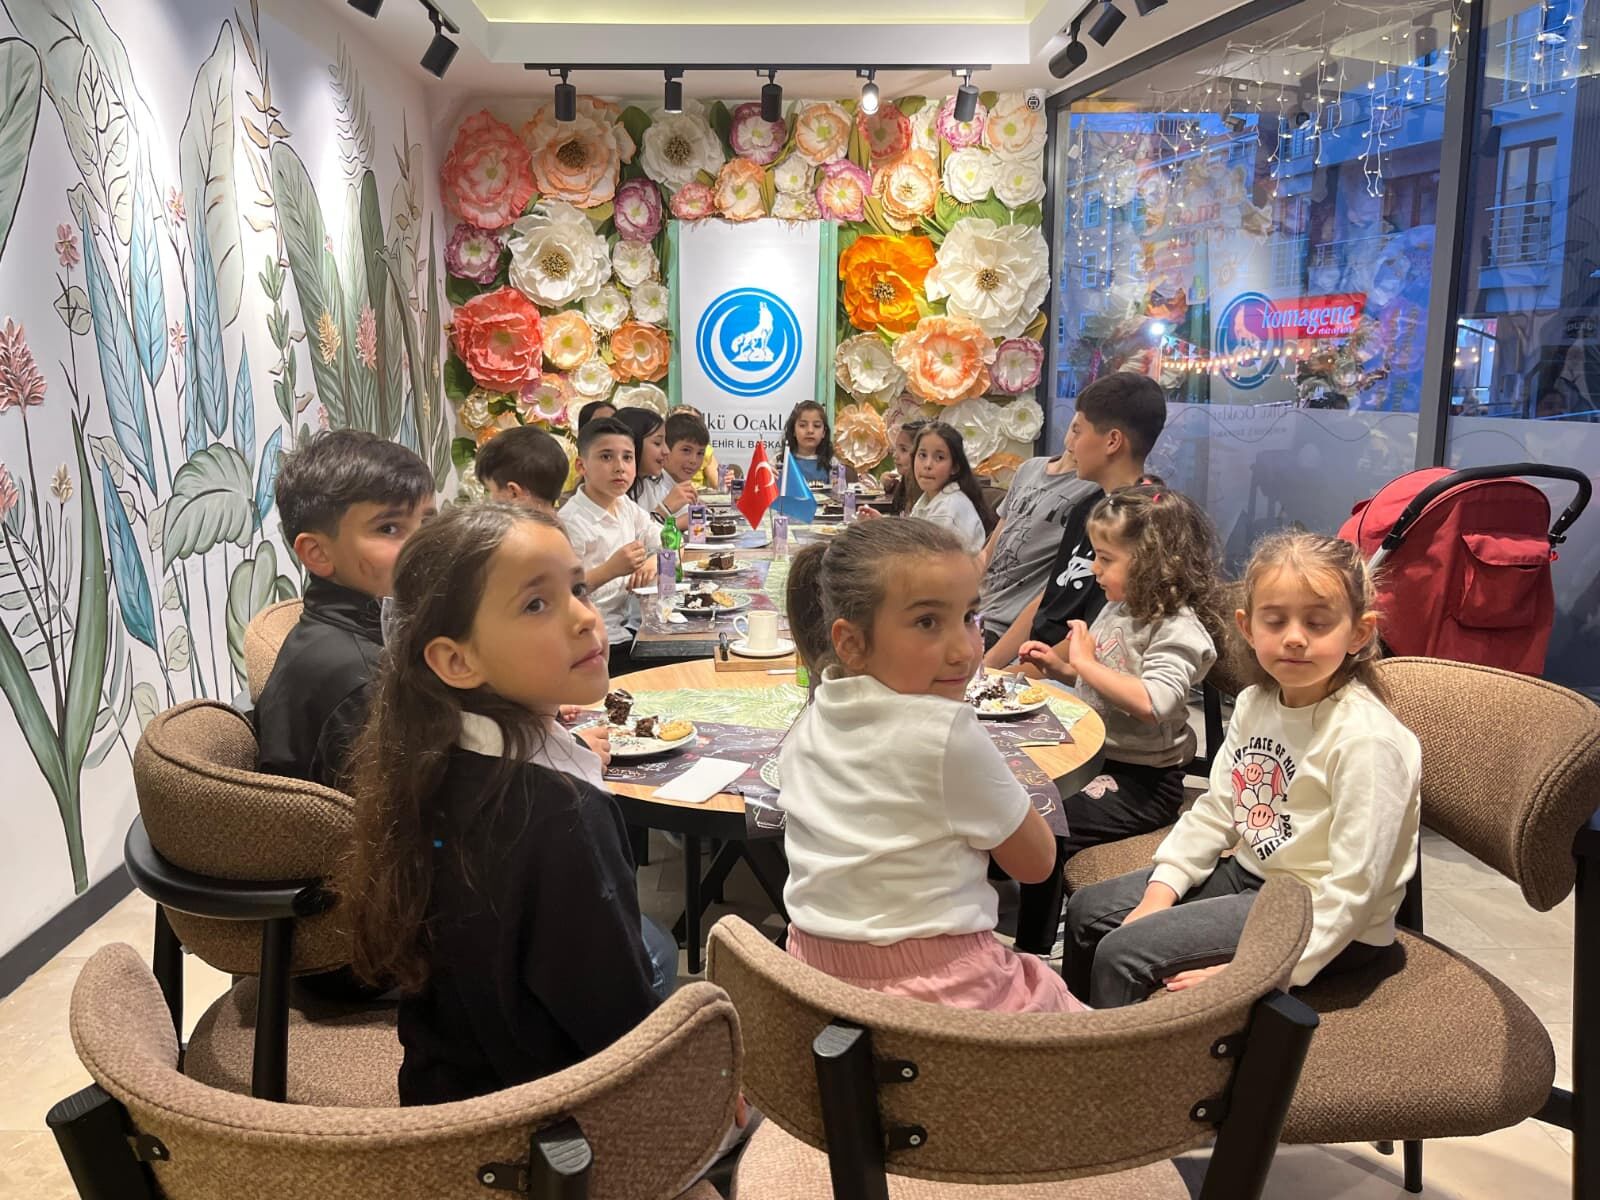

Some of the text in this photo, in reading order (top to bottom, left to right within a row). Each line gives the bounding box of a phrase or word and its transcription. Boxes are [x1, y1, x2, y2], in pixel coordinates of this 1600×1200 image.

[1261, 303, 1355, 335] komagene
[702, 412, 782, 431] kü Ocakl
[711, 438, 734, 449] EHİR
[737, 438, 746, 449] İL
[1249, 736, 1297, 781] TATE OF MIN
